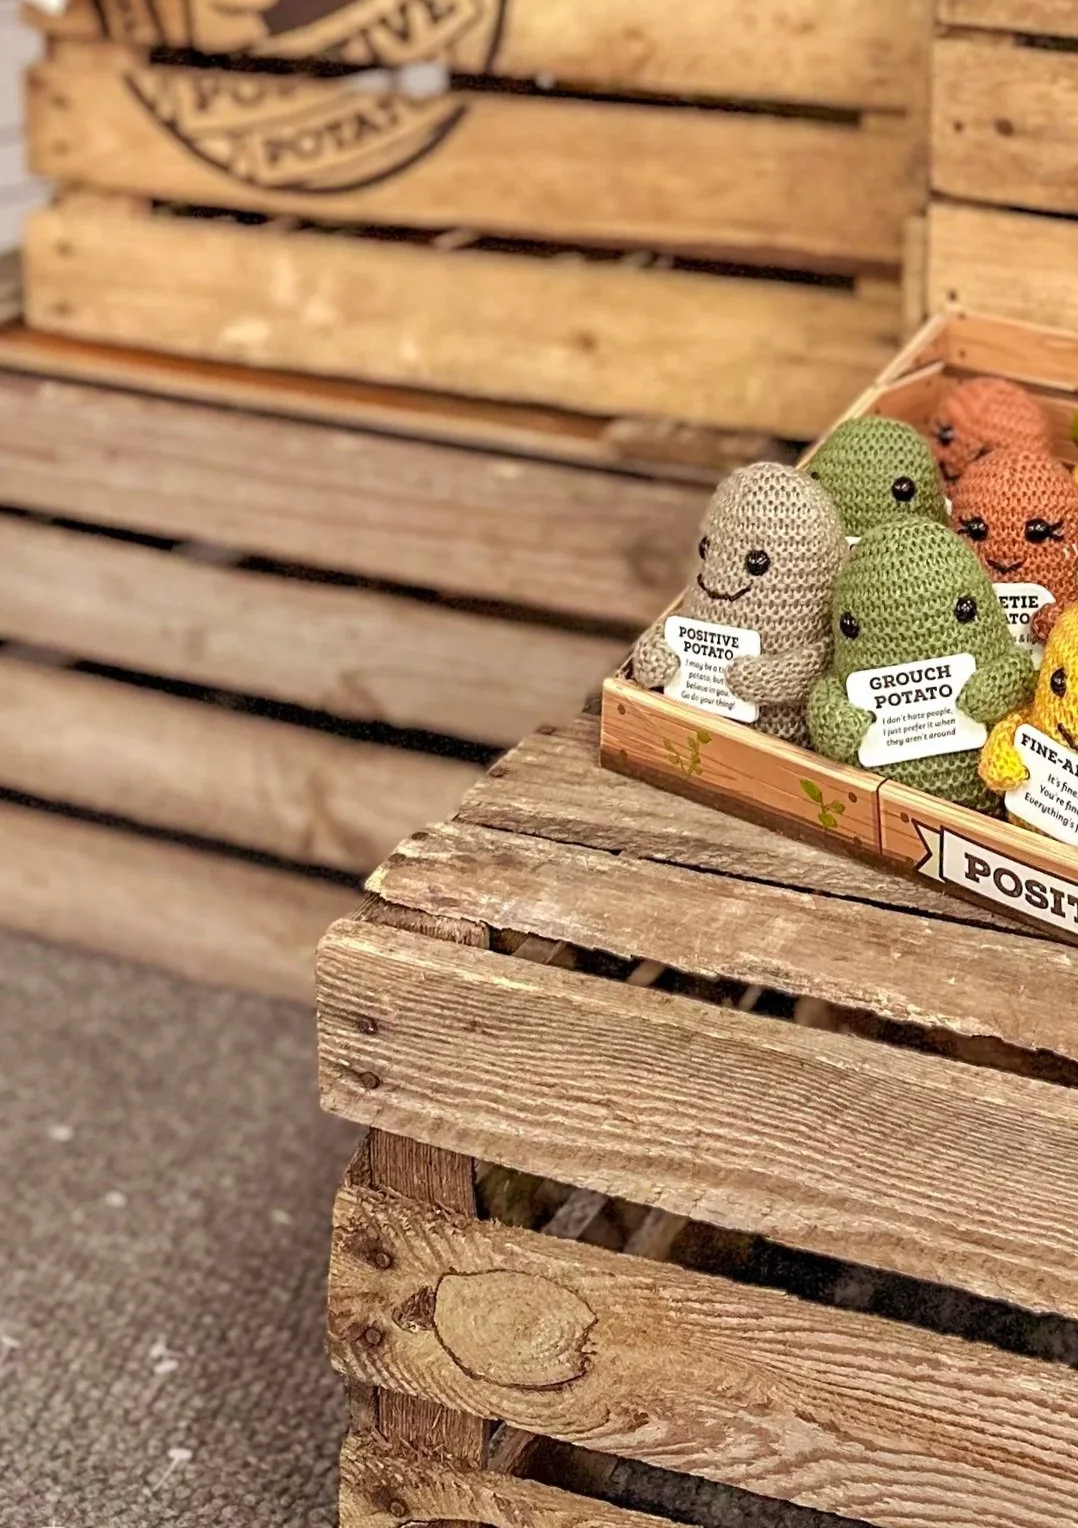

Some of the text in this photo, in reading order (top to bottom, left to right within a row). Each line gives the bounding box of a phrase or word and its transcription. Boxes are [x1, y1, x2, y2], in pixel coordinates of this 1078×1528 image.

[679, 626, 739, 648] POSITIVE
[684, 641, 733, 660] POTATO
[870, 665, 951, 690] GROUCH
[874, 684, 952, 709] POTATO
[886, 714, 906, 724] don't
[907, 712, 925, 720] hate
[888, 727, 901, 736] just
[904, 722, 926, 734] prefer
[935, 718, 955, 727] when
[886, 728, 956, 746] they aren't around
[1040, 784, 1064, 806] You're
[1048, 773, 1078, 799] It's fine.
[1024, 792, 1074, 828] Everything's
